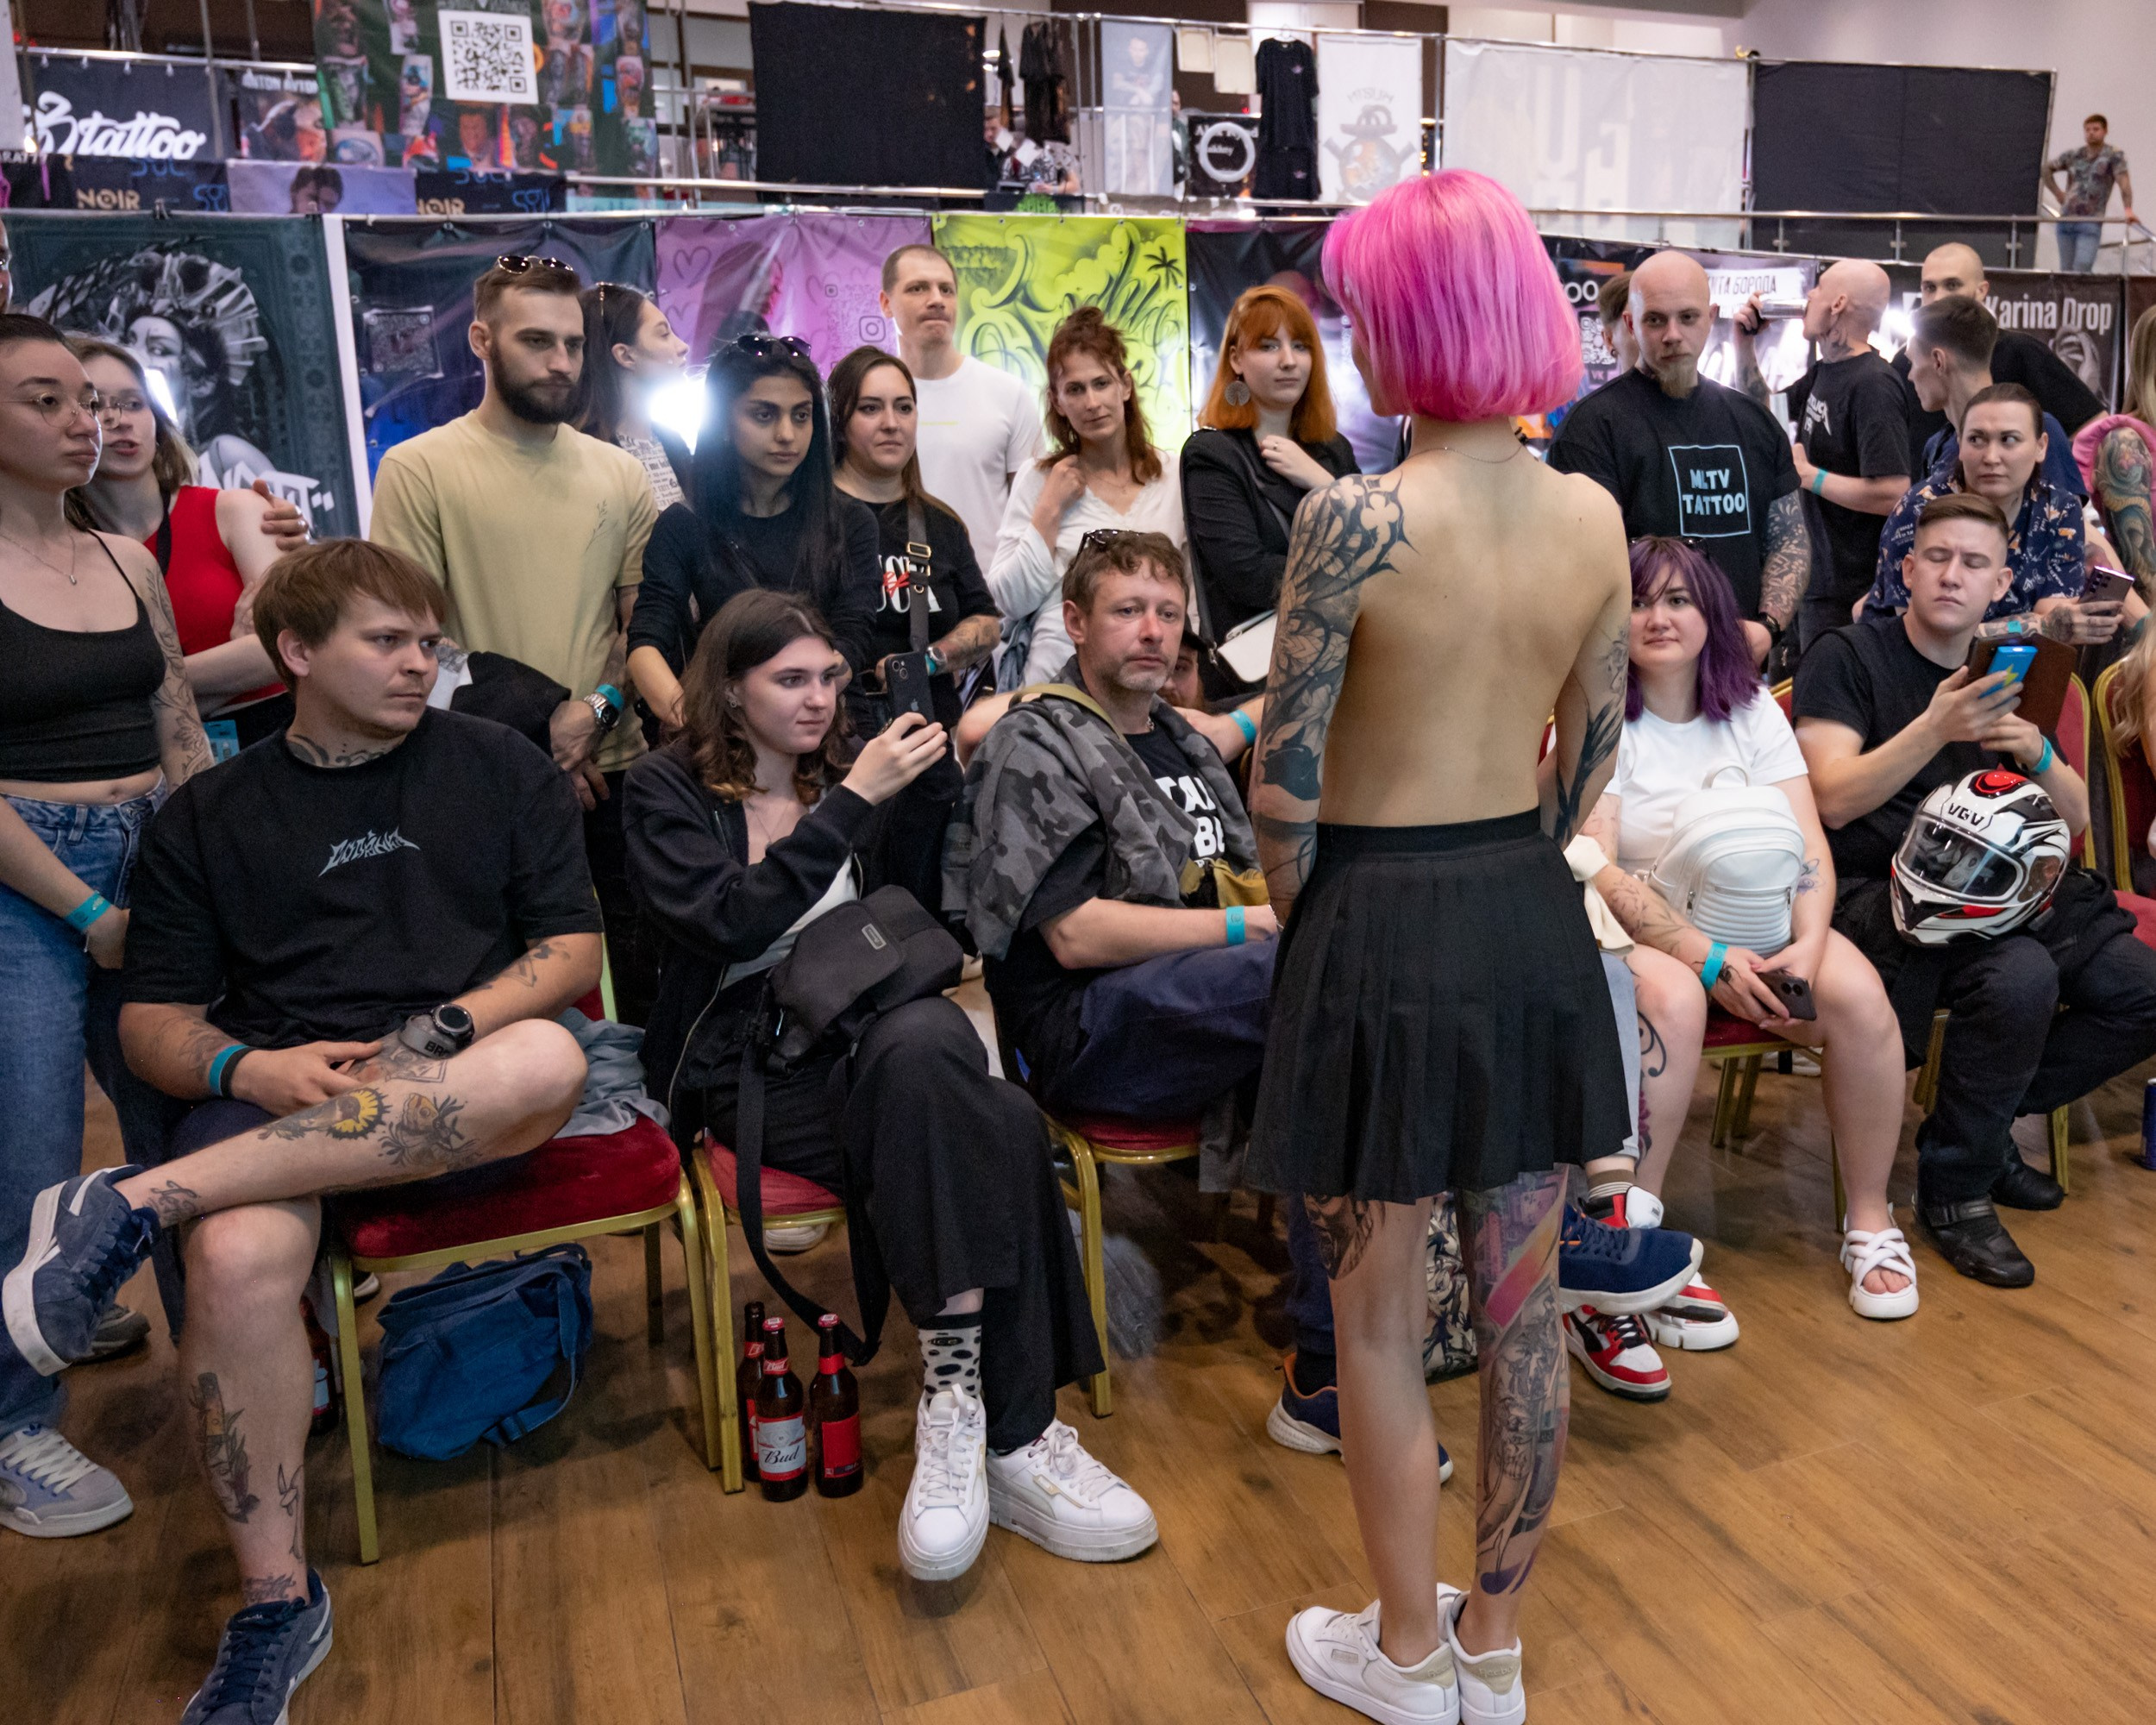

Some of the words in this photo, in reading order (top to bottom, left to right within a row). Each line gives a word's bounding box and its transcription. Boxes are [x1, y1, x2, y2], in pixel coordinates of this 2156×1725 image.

[76, 188, 141, 210] NOIR
[1564, 280, 1599, 303] OO
[1733, 275, 1777, 295] БОРОДА
[1984, 293, 2057, 329] Karina
[2062, 297, 2112, 336] Drop
[1682, 492, 1746, 516] TATTOO
[1947, 802, 1985, 826] VGV
[766, 1361, 785, 1371] Bud
[762, 1446, 799, 1465] Bud
